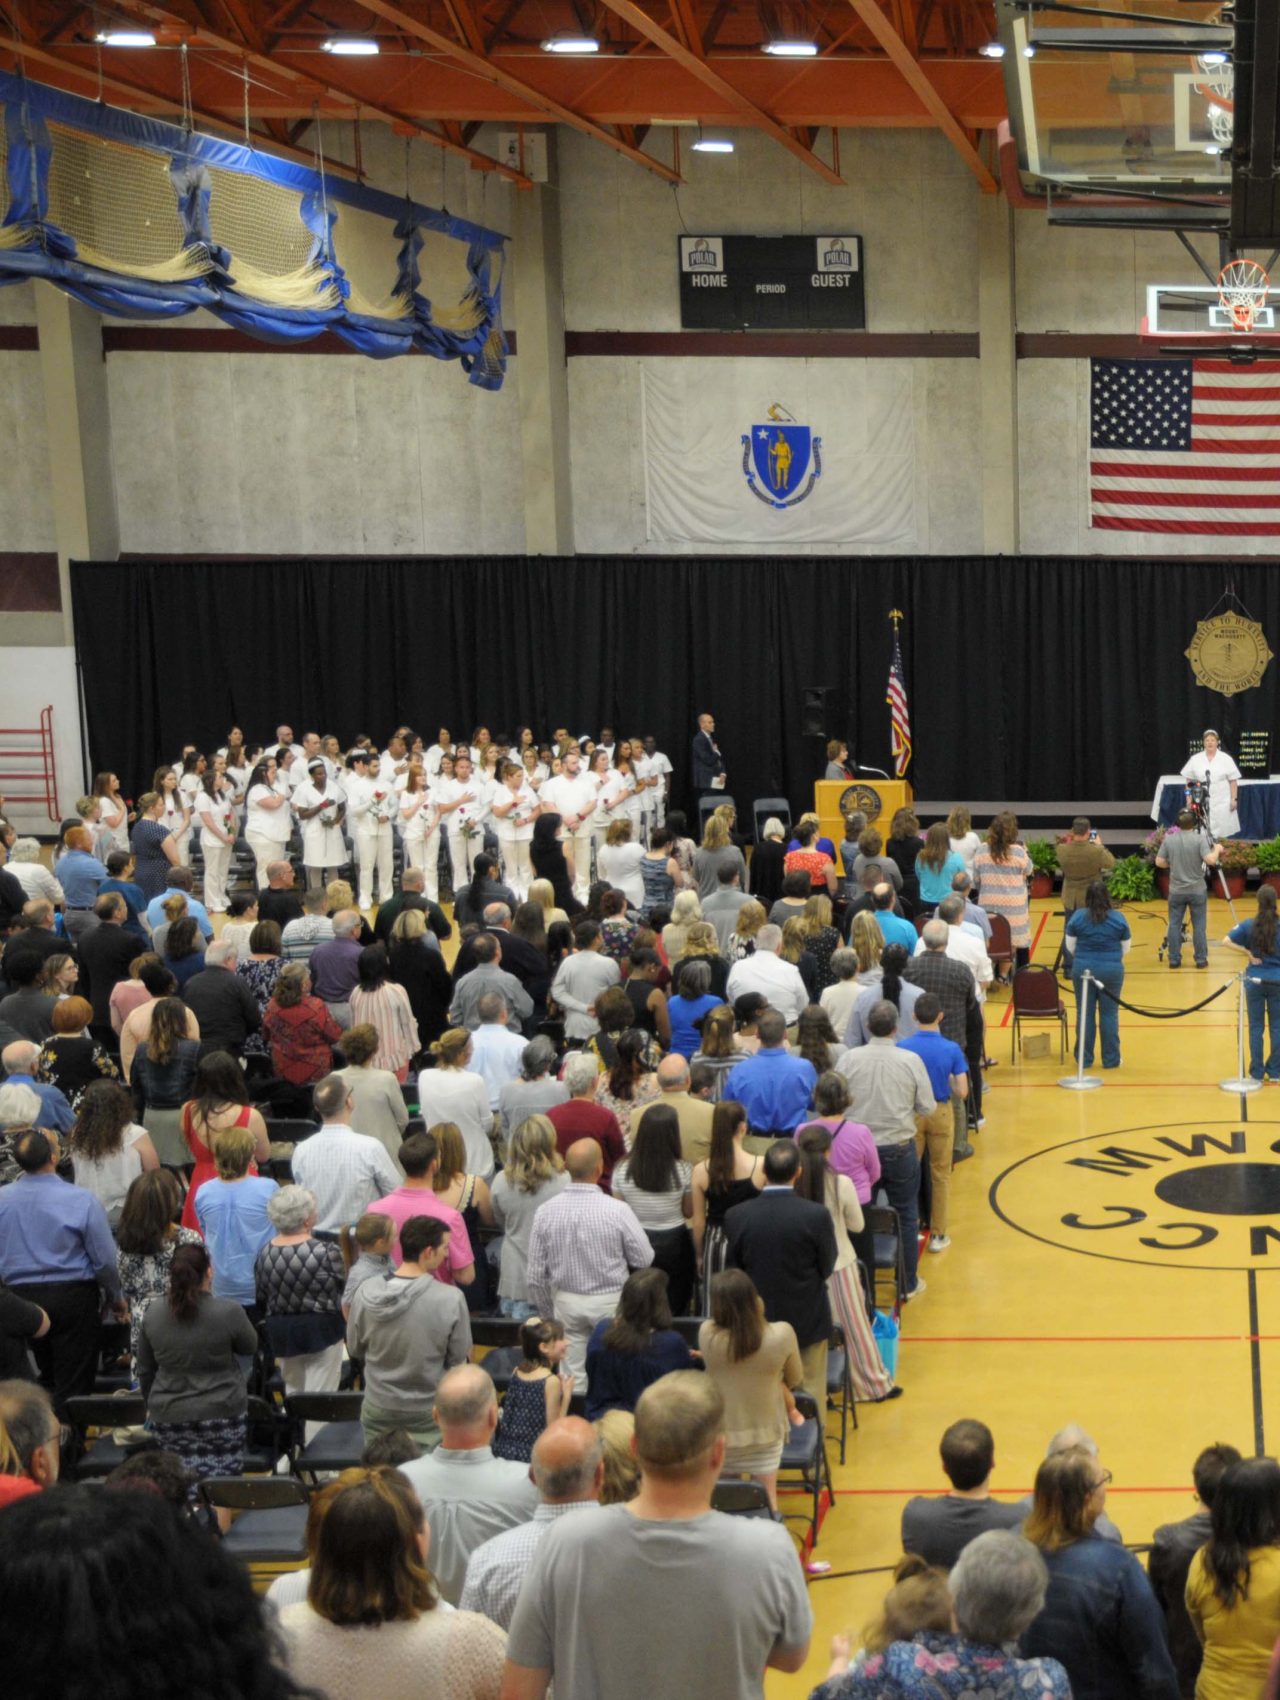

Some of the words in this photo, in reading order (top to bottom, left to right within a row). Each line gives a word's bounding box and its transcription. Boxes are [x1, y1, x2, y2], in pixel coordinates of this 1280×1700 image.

[691, 253, 715, 264] POLAR
[826, 252, 849, 264] POLAR
[692, 274, 728, 288] HOME
[811, 274, 851, 287] GUEST
[755, 284, 786, 294] PERIOD
[1192, 620, 1217, 650] SERVICE
[1219, 617, 1231, 625] TO
[1235, 617, 1267, 652] HUMANITY
[1197, 670, 1211, 683] AND
[1214, 683, 1230, 692] THE
[1234, 670, 1261, 690] WORLD
